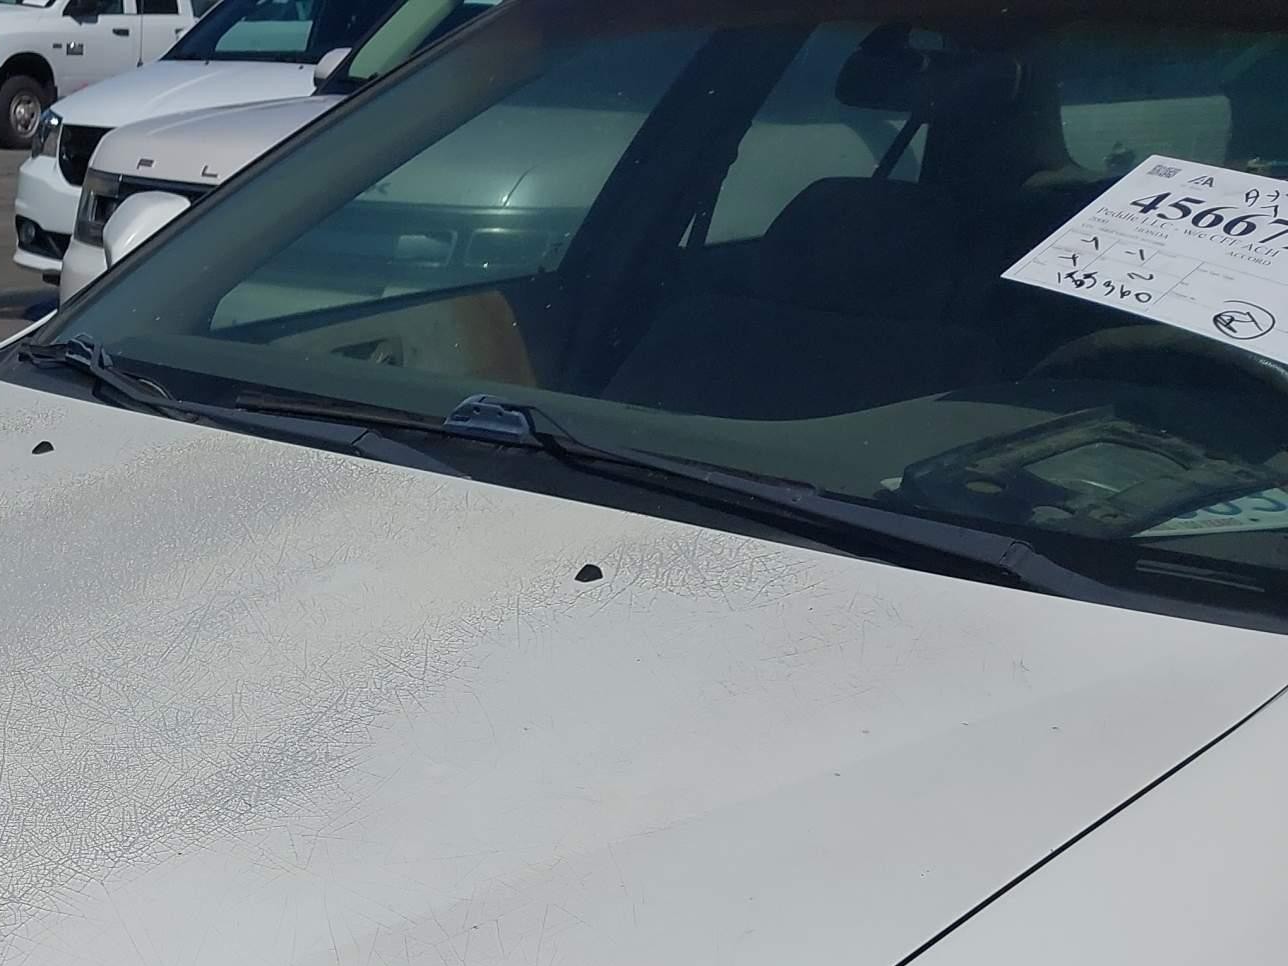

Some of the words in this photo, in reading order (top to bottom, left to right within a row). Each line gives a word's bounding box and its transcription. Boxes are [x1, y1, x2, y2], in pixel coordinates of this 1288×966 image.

[1096, 206, 1139, 222] Peddle
[1140, 216, 1173, 229] LLC
[1240, 242, 1280, 257] ACH
[1129, 192, 1288, 250] 45667
[1225, 250, 1272, 266] ACCORD
